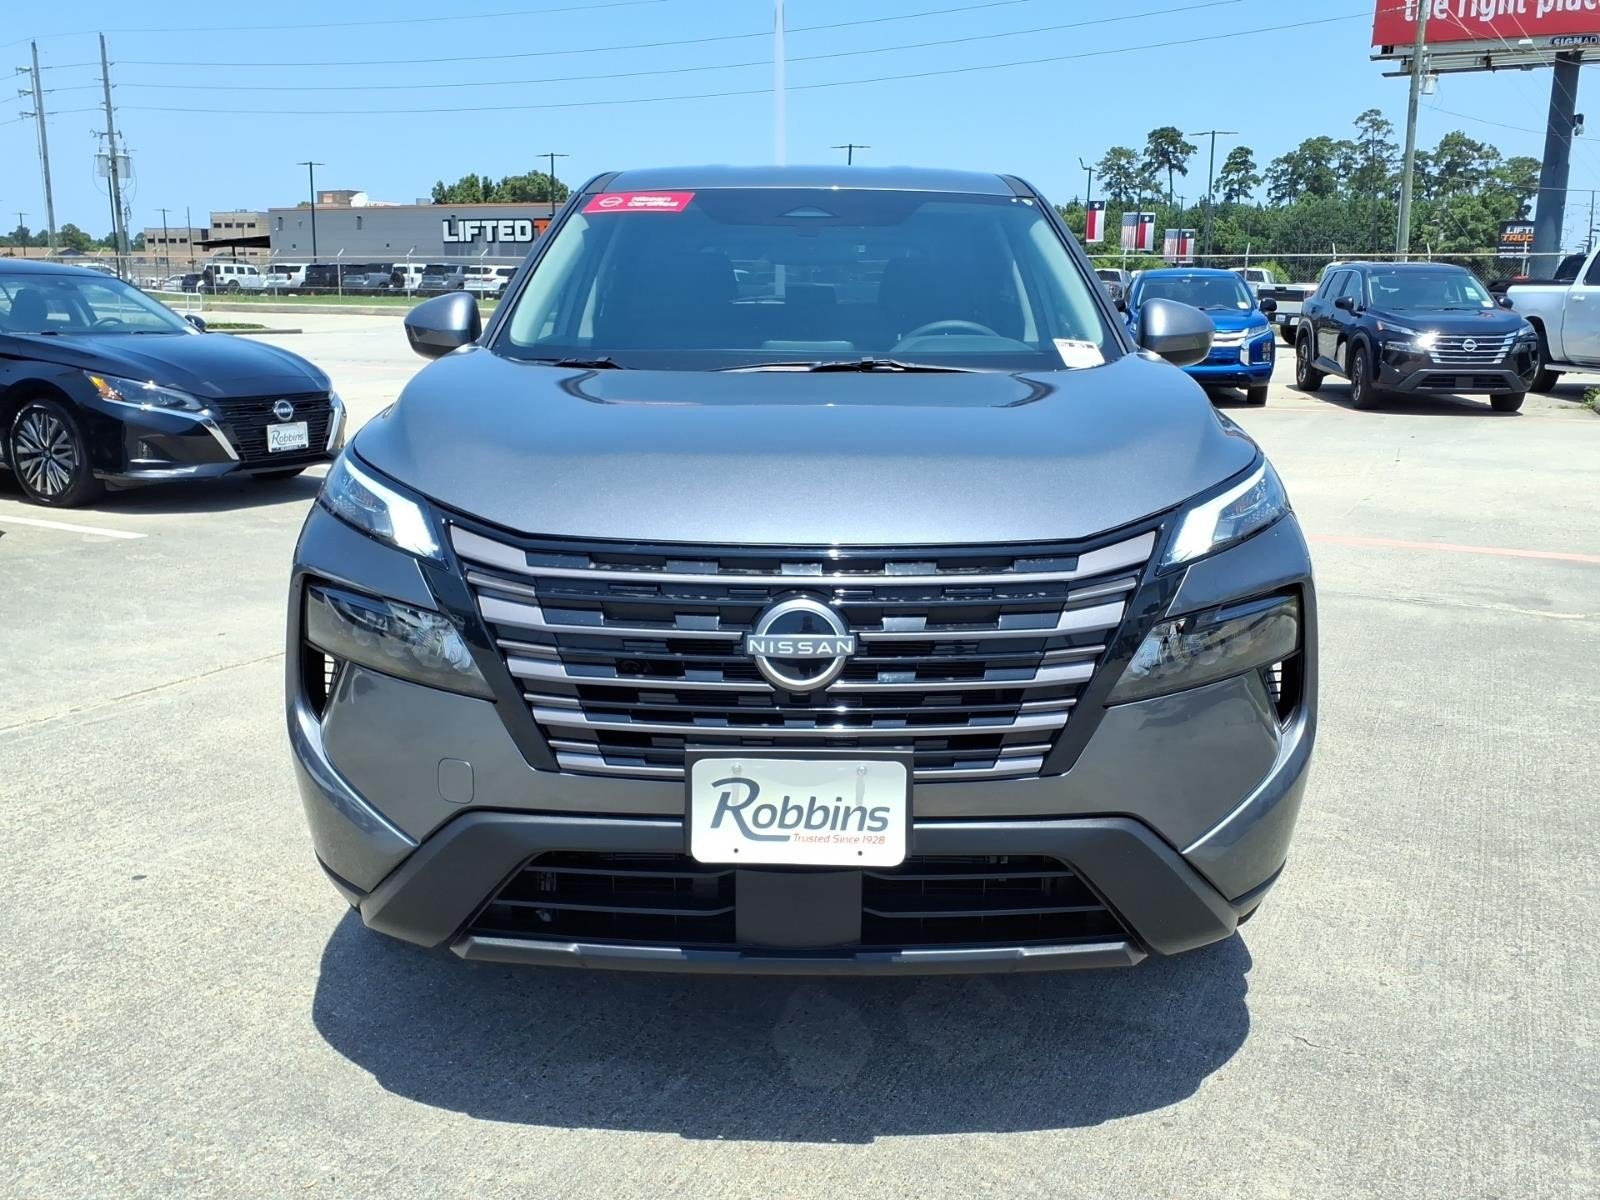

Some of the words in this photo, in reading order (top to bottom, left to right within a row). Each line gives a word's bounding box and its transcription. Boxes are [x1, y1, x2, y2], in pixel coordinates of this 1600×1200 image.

[442, 219, 534, 243] LIFTED
[1506, 226, 1534, 234] LIFT
[271, 431, 304, 445] Robbins
[749, 639, 853, 655] NISSAN
[710, 777, 890, 842] Robbins
[793, 833, 830, 843] Trusted
[833, 834, 860, 844] Since
[863, 835, 886, 845] 1928
